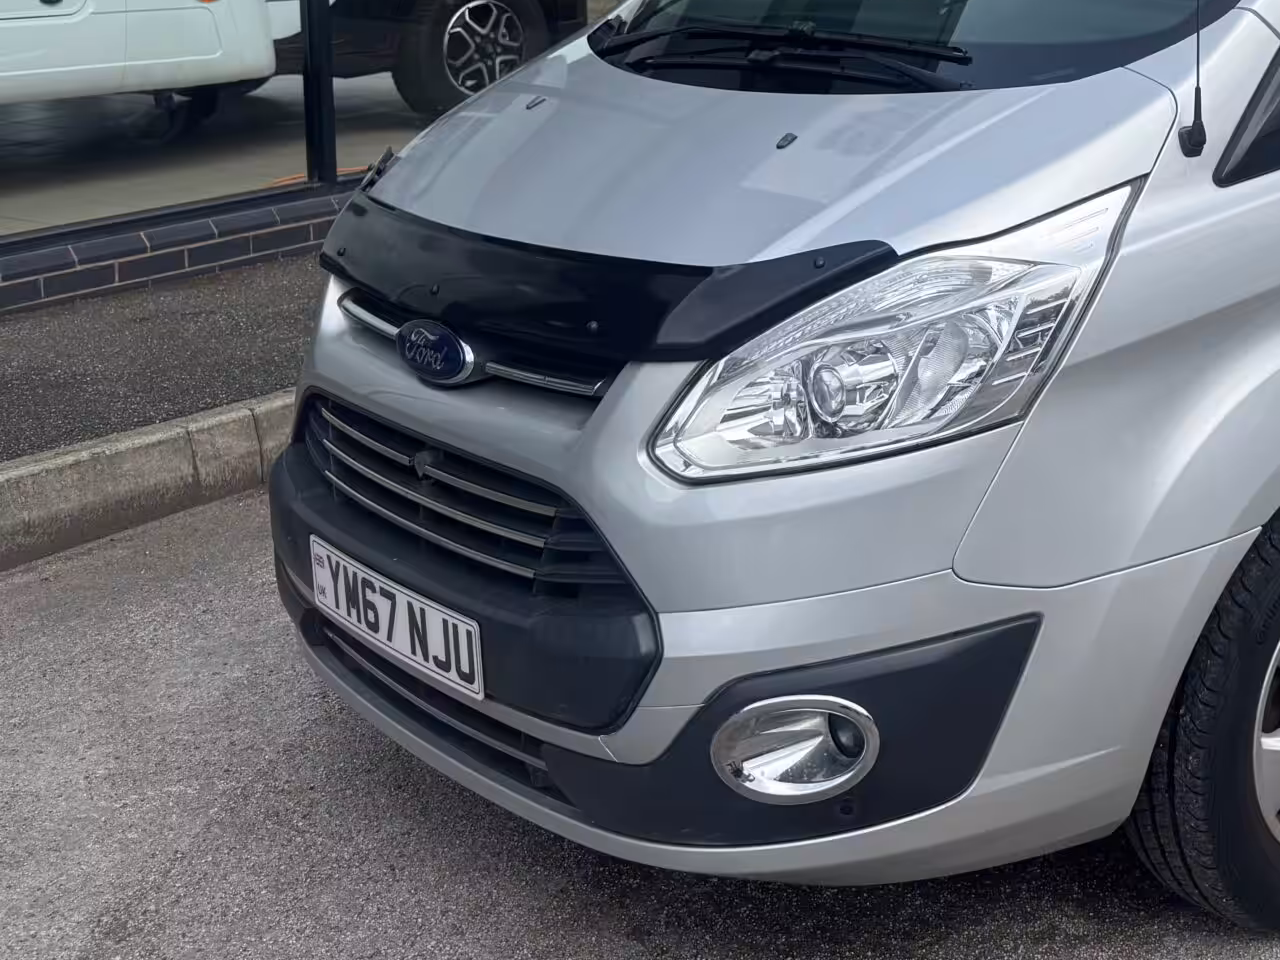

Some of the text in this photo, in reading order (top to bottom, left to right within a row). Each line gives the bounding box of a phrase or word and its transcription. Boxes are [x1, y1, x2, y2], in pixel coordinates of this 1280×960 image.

[405, 327, 448, 370] Ford
[326, 553, 476, 686] YM67 NJU
